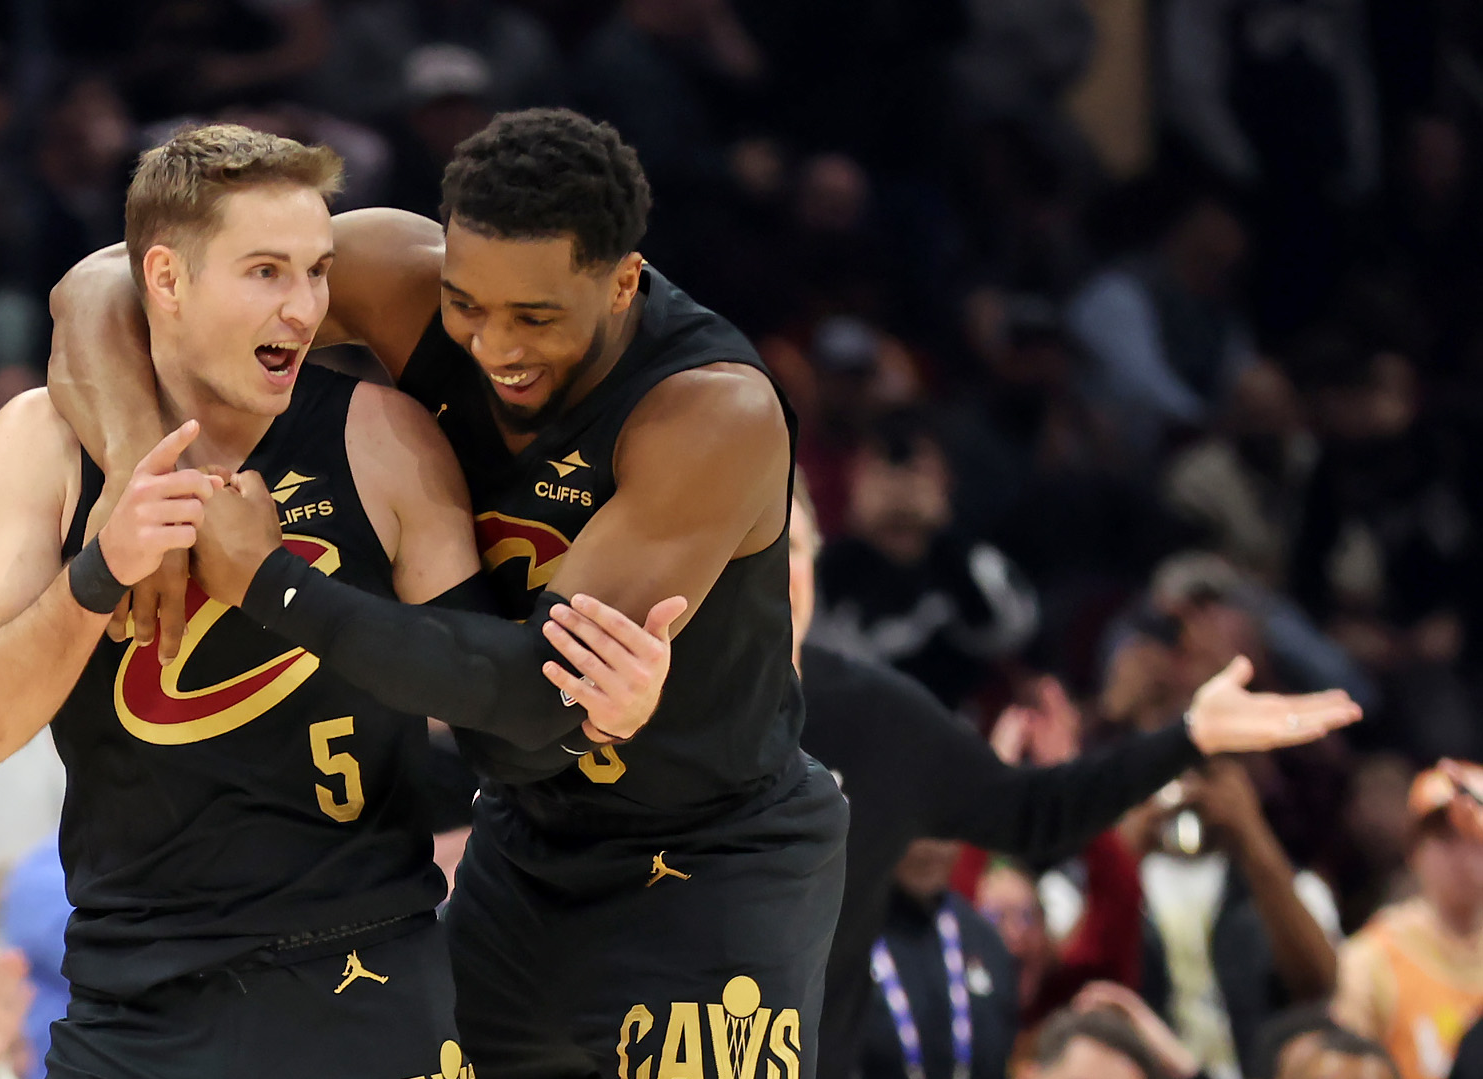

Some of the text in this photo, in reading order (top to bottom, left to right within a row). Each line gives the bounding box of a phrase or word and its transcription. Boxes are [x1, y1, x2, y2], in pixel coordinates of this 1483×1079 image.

[534, 481, 594, 507] CLIFFS
[279, 500, 335, 527] IFFS
[309, 715, 365, 823] 5
